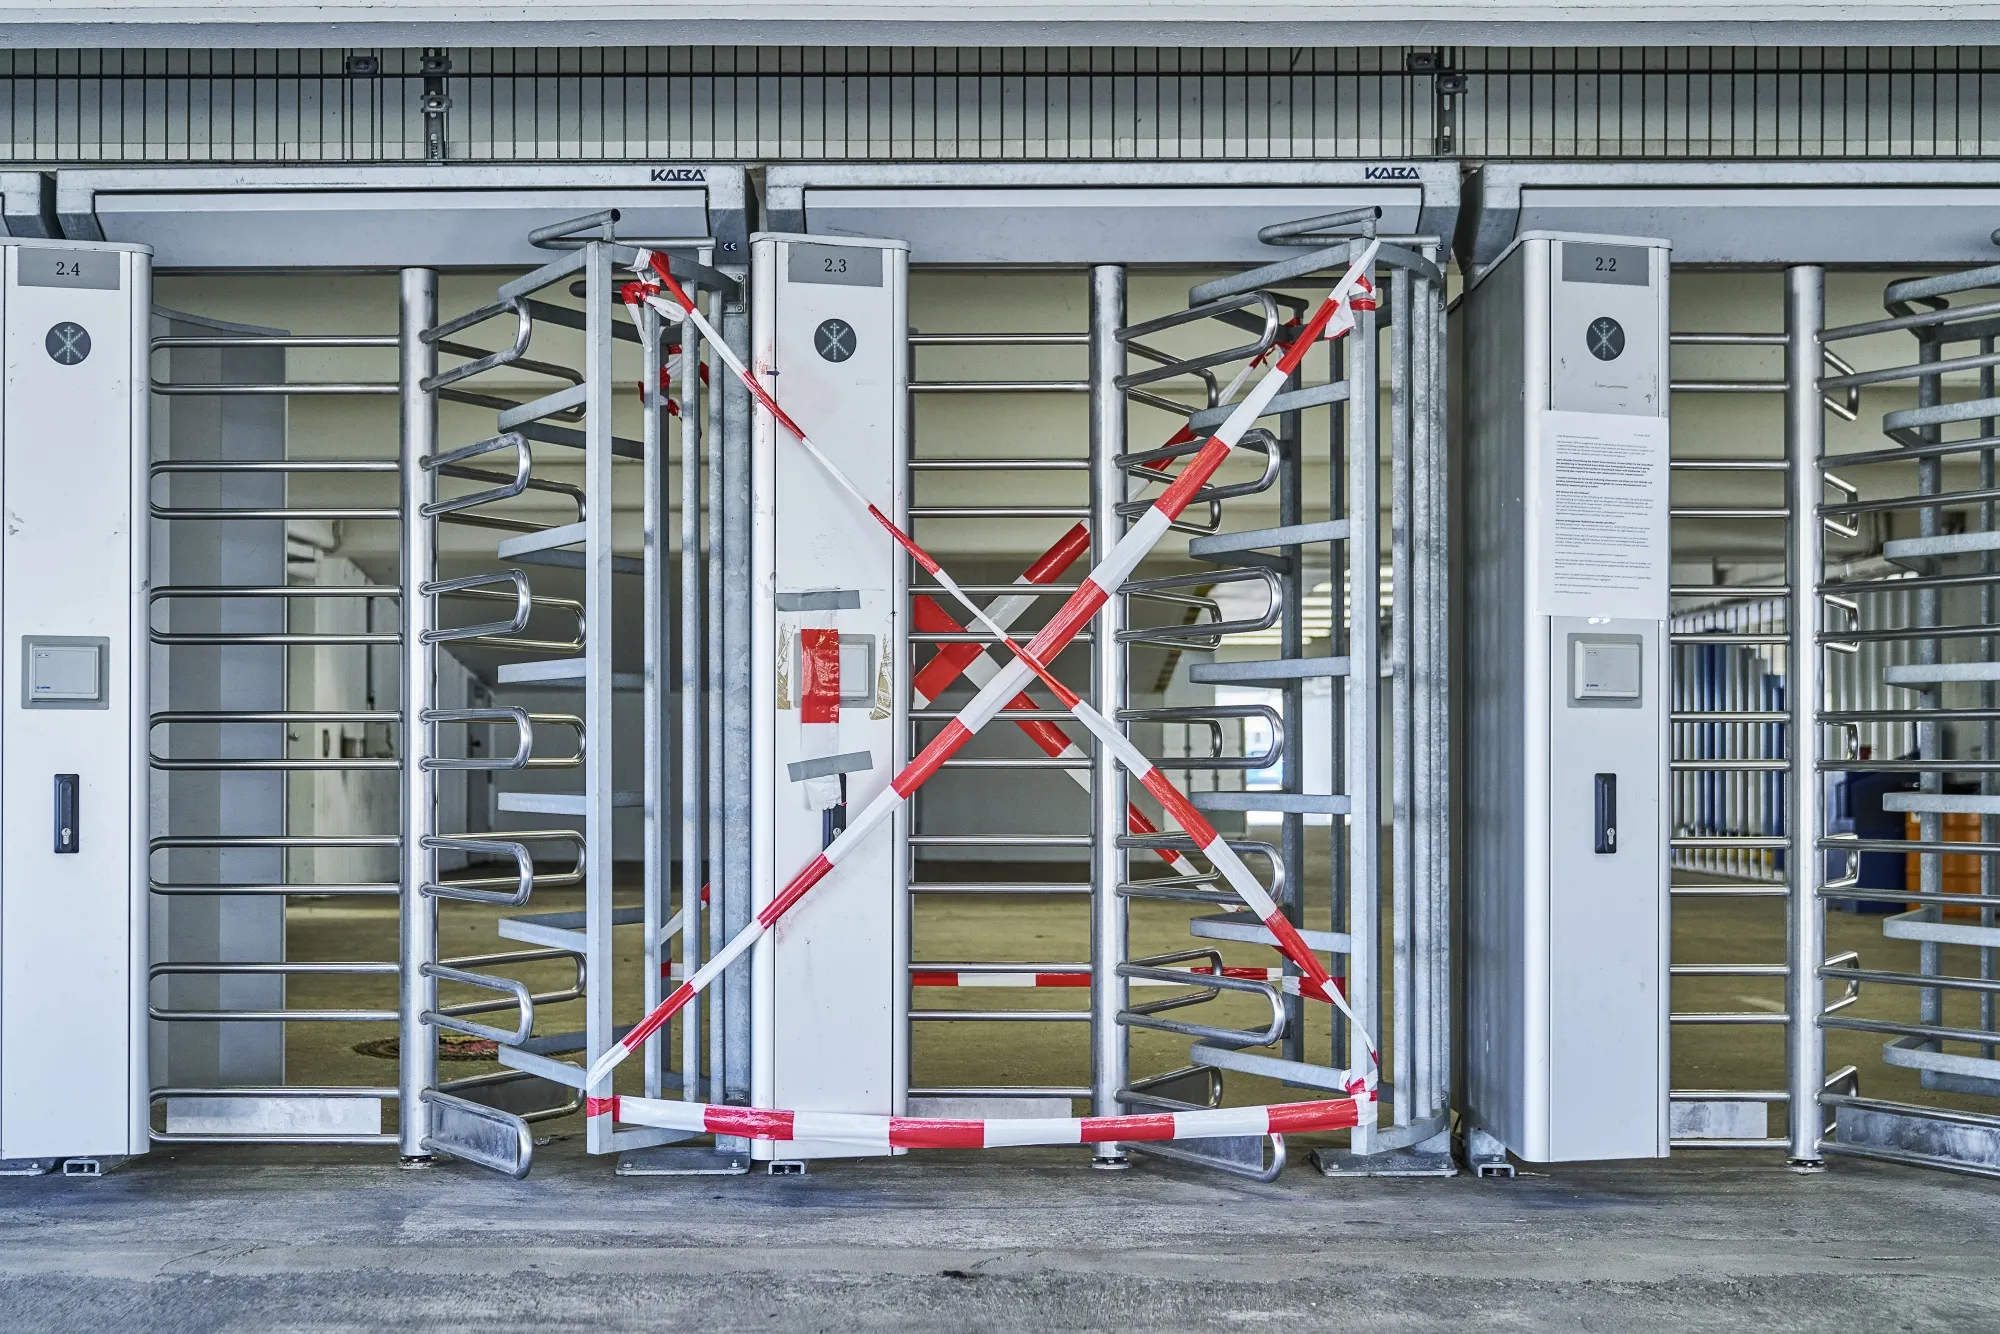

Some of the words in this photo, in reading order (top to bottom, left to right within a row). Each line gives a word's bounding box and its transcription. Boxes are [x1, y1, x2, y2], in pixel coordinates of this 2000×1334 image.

[651, 169, 706, 182] KABA
[1365, 167, 1420, 180] KABA
[723, 242, 737, 251] CE
[56, 261, 81, 276] 2.4
[824, 258, 847, 273] 2.3
[1595, 256, 1617, 272] 2.2
